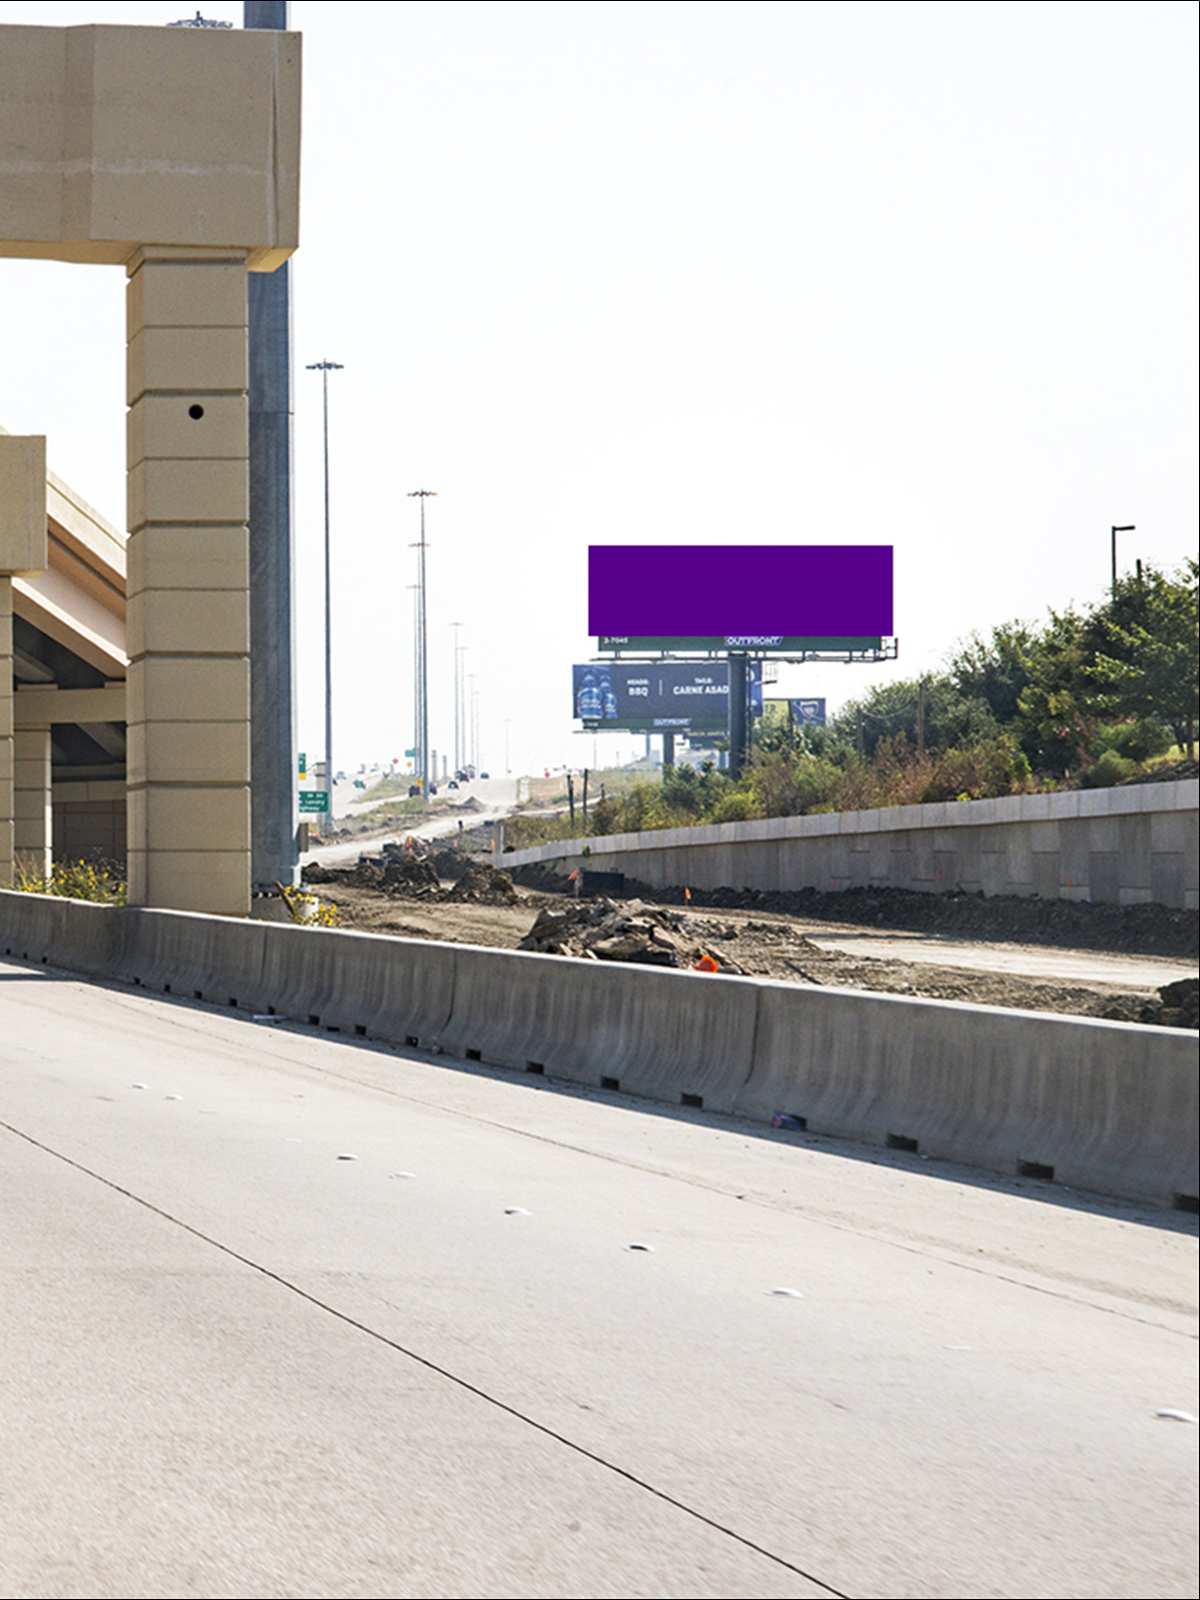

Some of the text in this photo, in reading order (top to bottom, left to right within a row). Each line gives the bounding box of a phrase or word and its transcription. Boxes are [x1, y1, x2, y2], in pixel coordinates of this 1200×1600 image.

[726, 636, 782, 646] OUTFRONT
[628, 687, 649, 697] BBQ
[673, 684, 729, 695] CARNE ASAD
